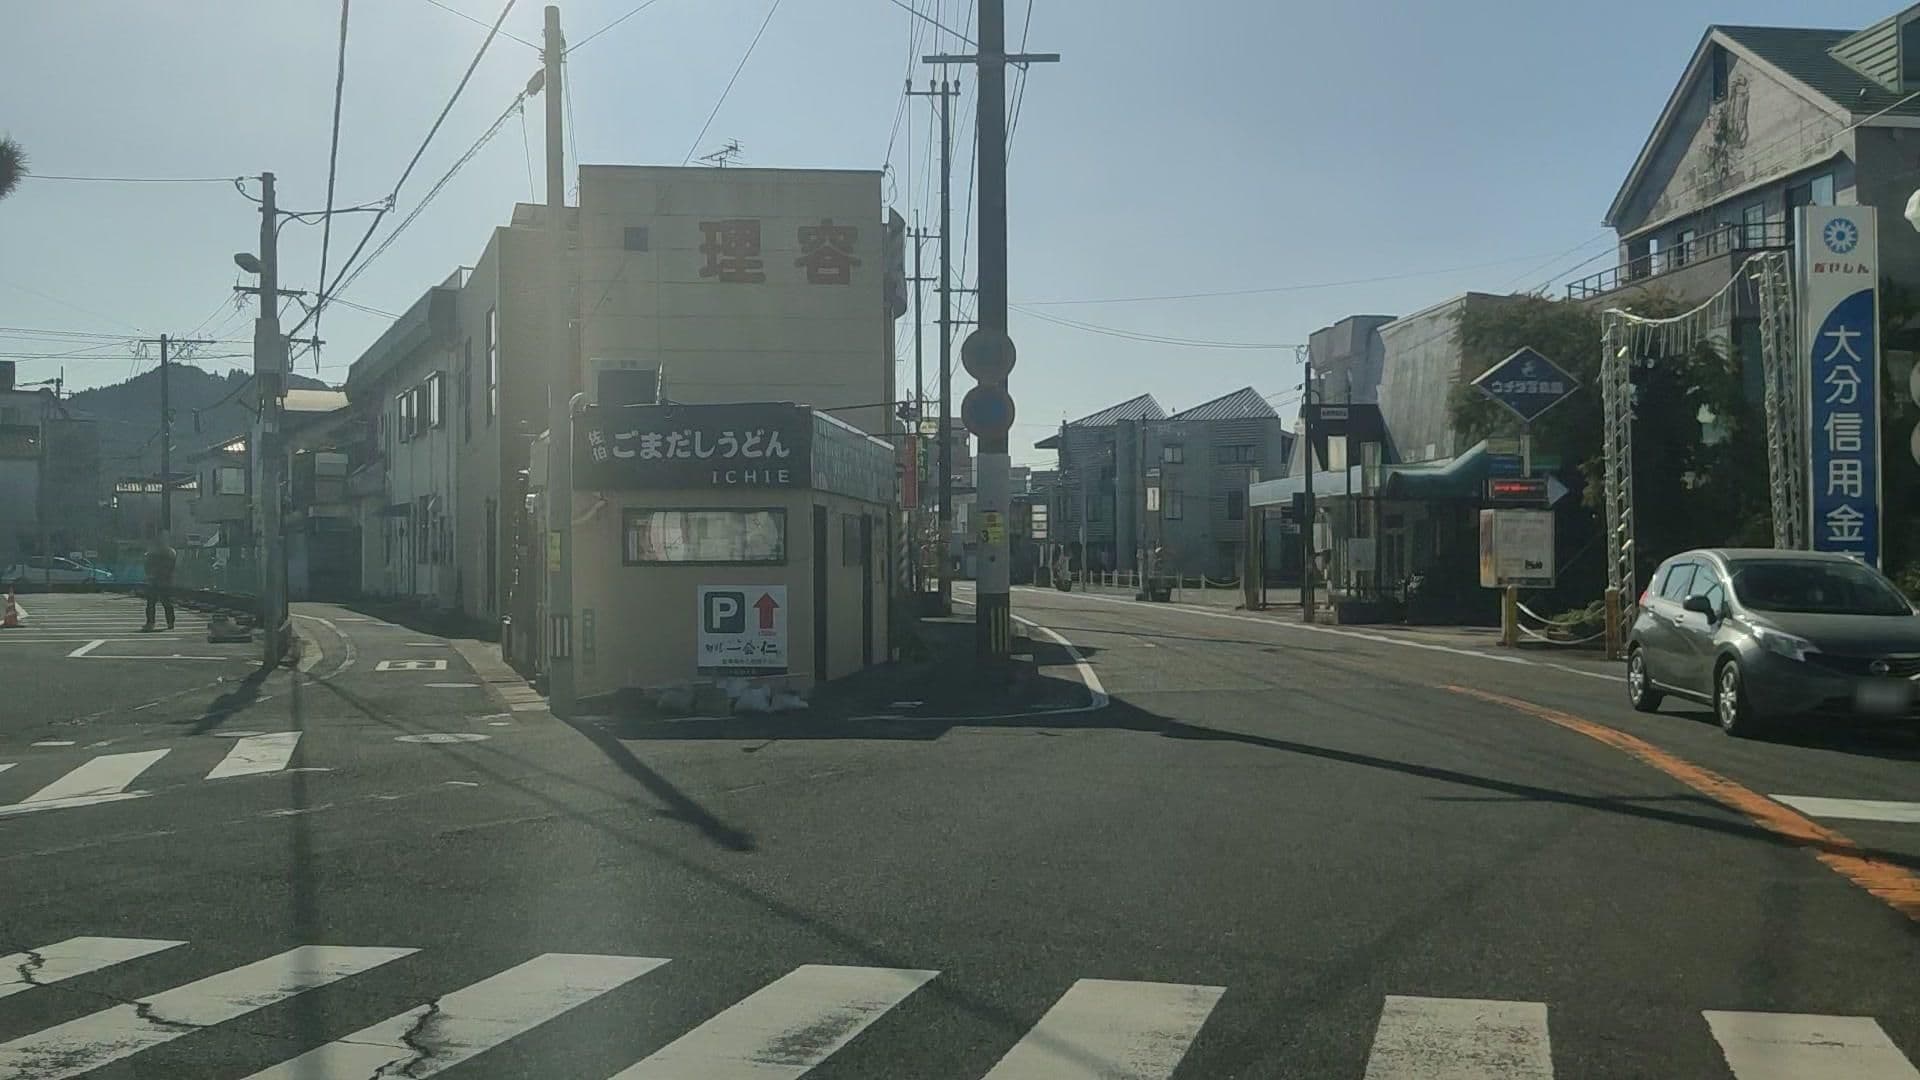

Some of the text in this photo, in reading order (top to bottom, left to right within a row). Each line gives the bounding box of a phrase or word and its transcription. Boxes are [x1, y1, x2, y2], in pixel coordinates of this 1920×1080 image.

[698, 218, 861, 285] 理容
[612, 429, 790, 459] ごまだしうどん
[1824, 325, 1865, 561] 大分信用金
[712, 470, 790, 484] ICHIE
[712, 597, 738, 628] P
